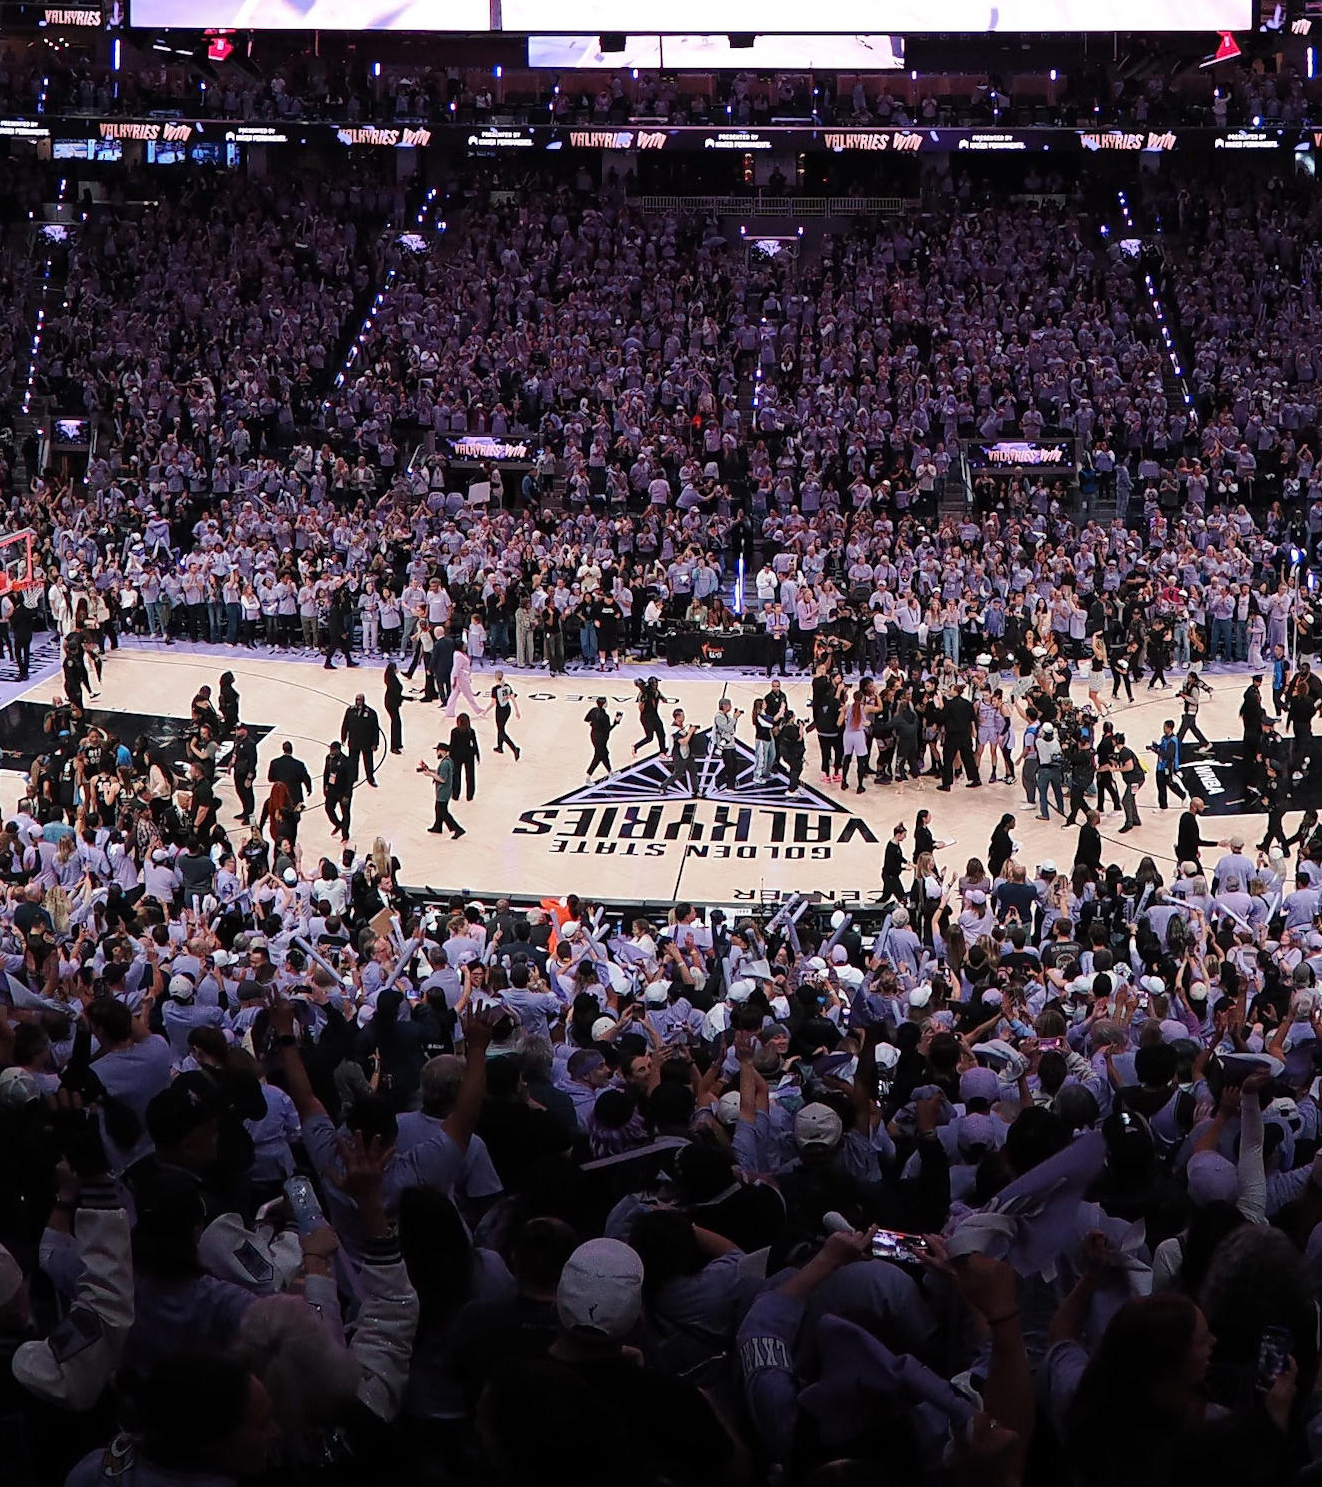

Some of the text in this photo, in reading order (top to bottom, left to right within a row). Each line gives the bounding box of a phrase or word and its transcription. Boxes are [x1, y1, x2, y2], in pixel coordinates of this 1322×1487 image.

[44, 8, 101, 26] VALKYRIES
[100, 122, 192, 141] VALKYRIES WIN
[402, 127, 431, 146] WIN
[637, 131, 667, 150] WIN
[1147, 132, 1176, 150] WIN
[824, 132, 923, 152] VALKYRIES WIN
[512, 804, 880, 844] VALKYRIES
[549, 838, 832, 861] STATE GOLDEN
